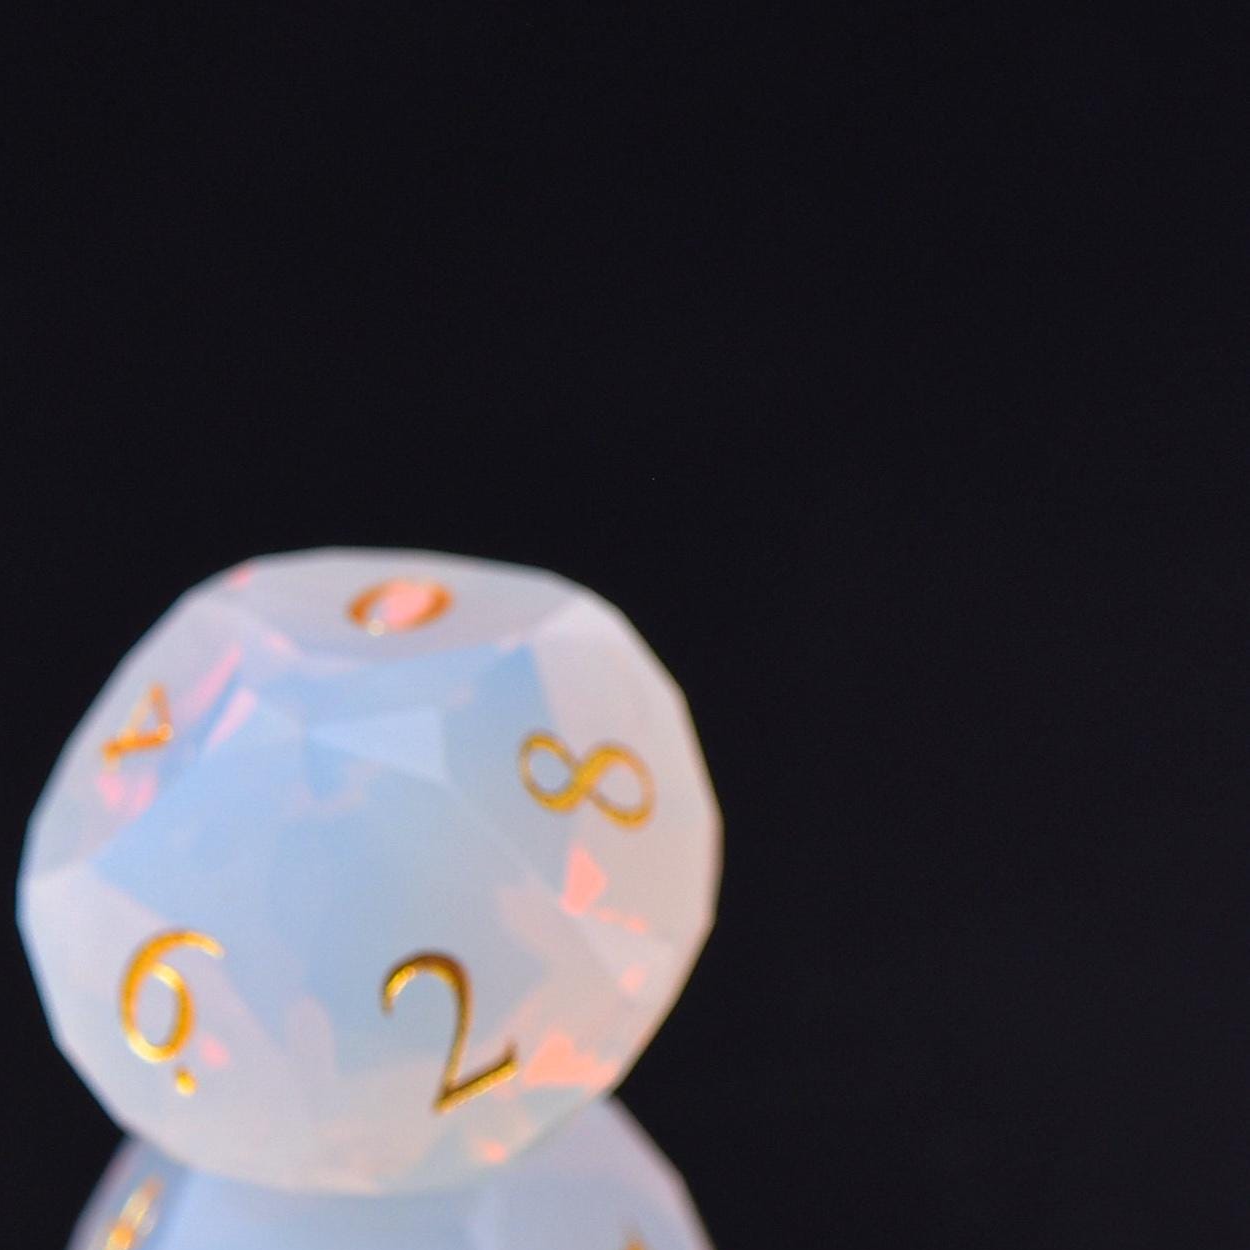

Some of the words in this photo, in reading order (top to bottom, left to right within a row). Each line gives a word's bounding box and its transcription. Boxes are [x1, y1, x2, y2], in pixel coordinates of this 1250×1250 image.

[347, 578, 454, 634] 0
[518, 730, 654, 830] 8
[380, 949, 520, 1116] 2
